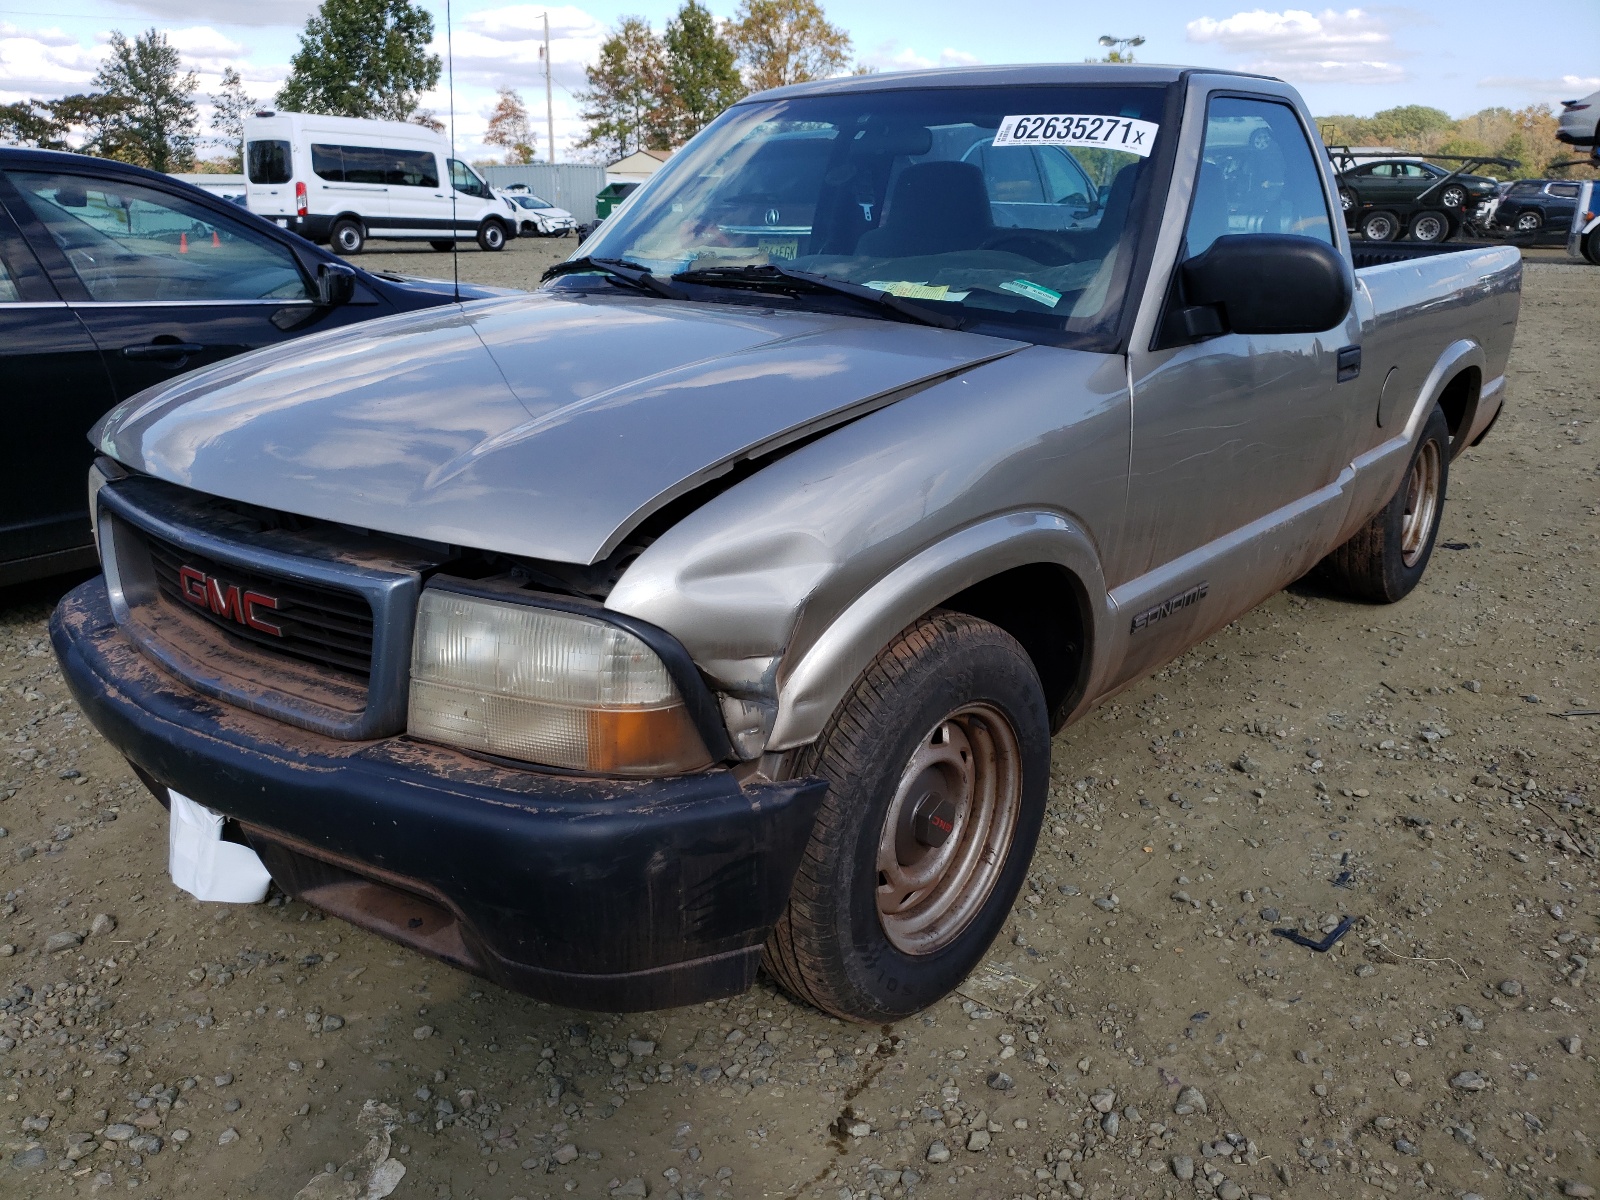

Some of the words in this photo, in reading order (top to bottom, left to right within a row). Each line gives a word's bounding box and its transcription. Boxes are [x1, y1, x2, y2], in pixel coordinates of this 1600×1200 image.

[1013, 116, 1133, 144] 62635271
[179, 565, 283, 637] GMC
[931, 815, 953, 833] GMC
